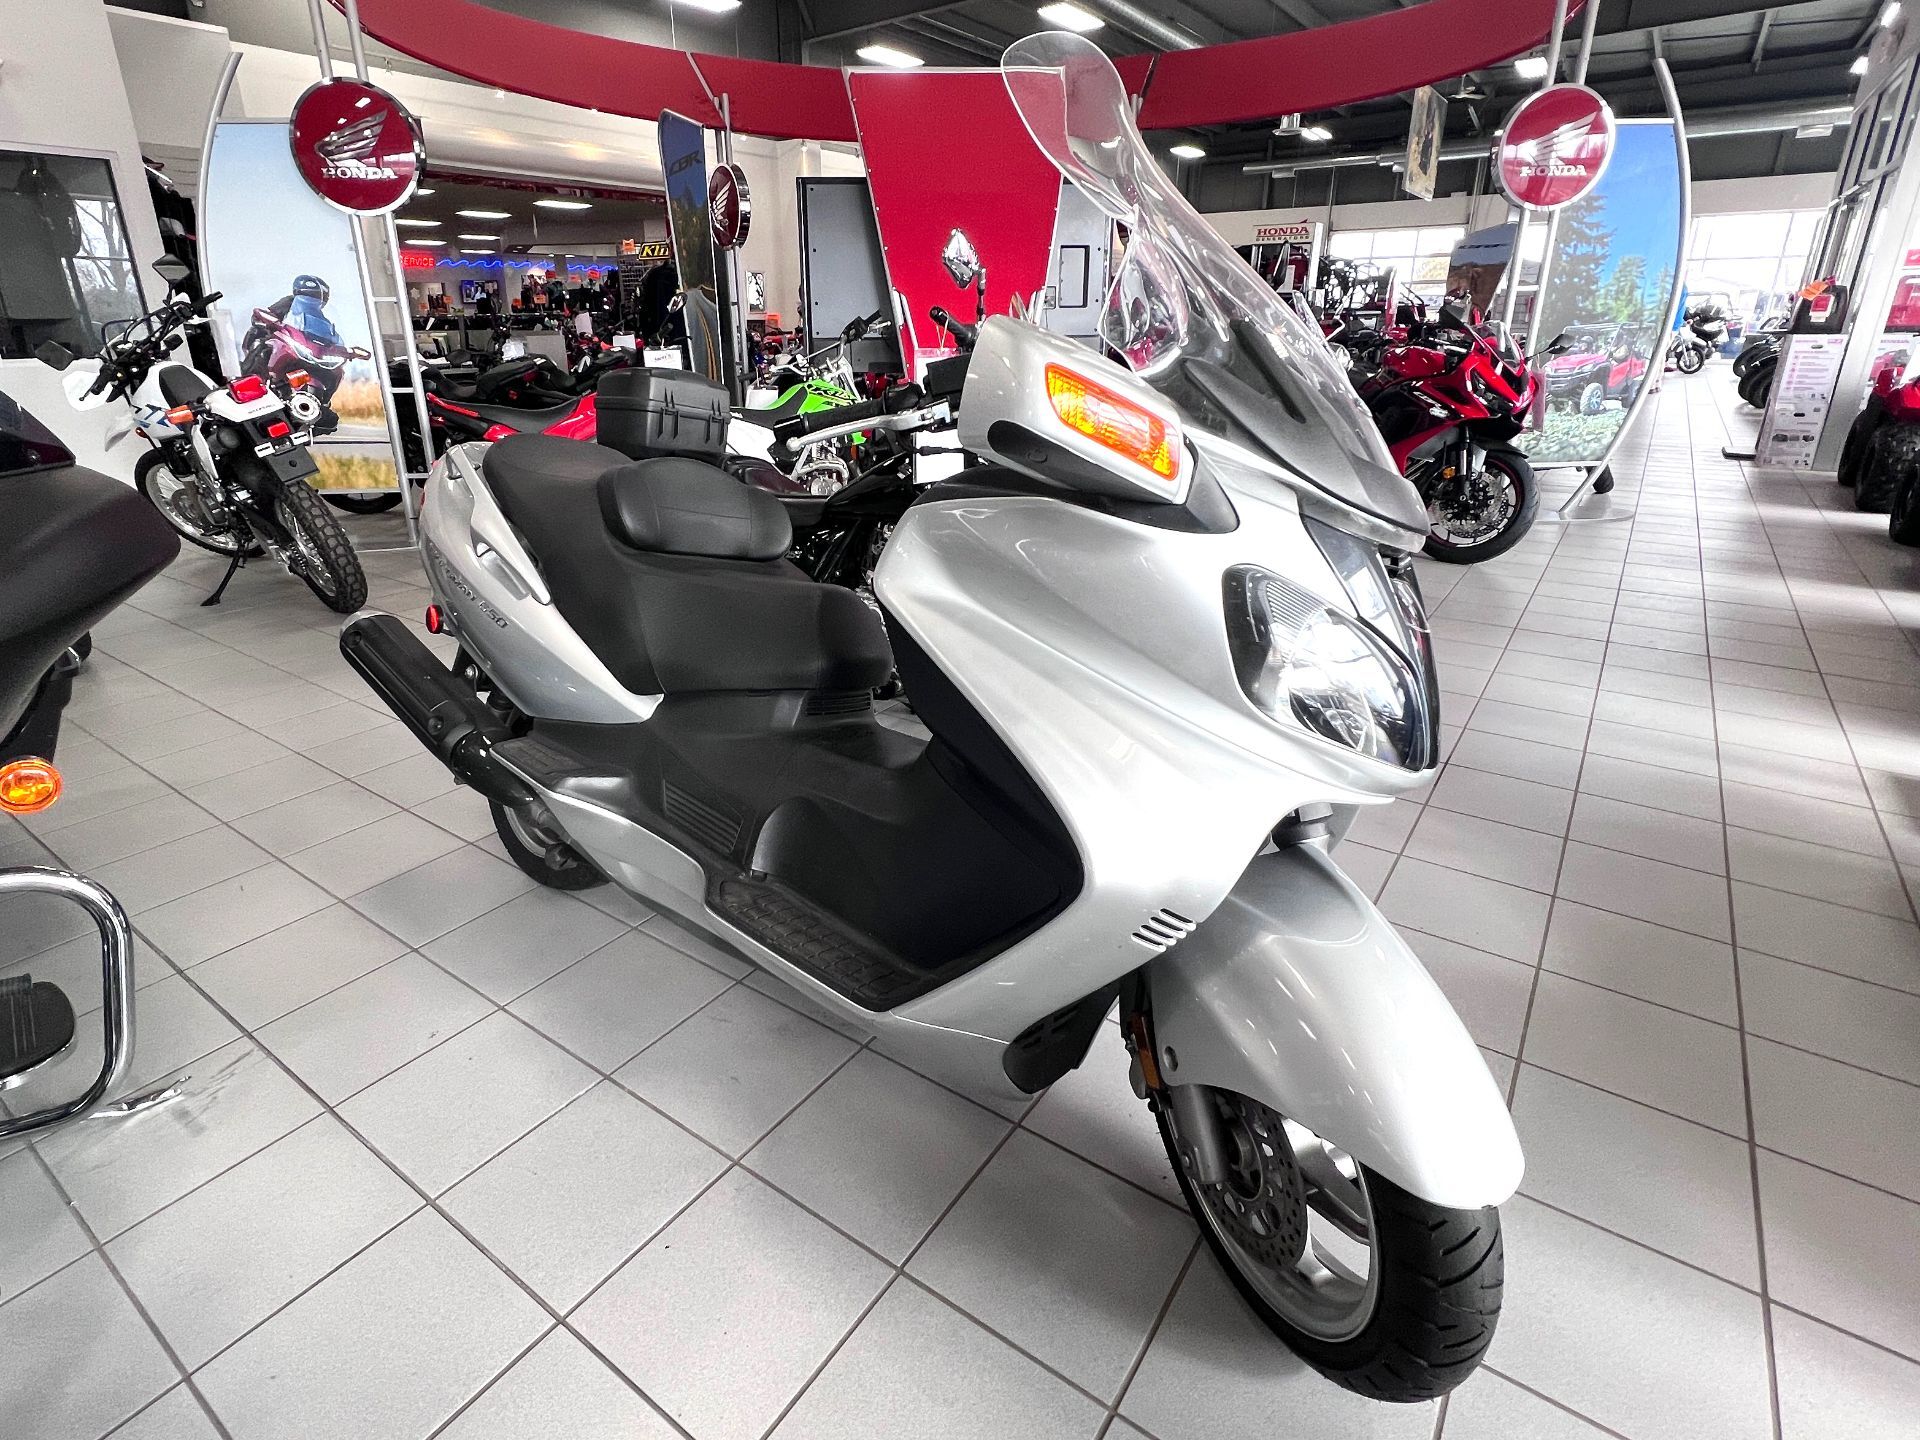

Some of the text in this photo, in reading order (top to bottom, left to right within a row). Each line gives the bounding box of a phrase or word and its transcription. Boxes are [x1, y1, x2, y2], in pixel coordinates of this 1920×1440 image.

[669, 150, 703, 176] CBR
[320, 166, 399, 180] HONDA
[1520, 165, 1587, 177] HONDA
[1256, 226, 1310, 236] HONDA
[478, 600, 508, 629] 650
